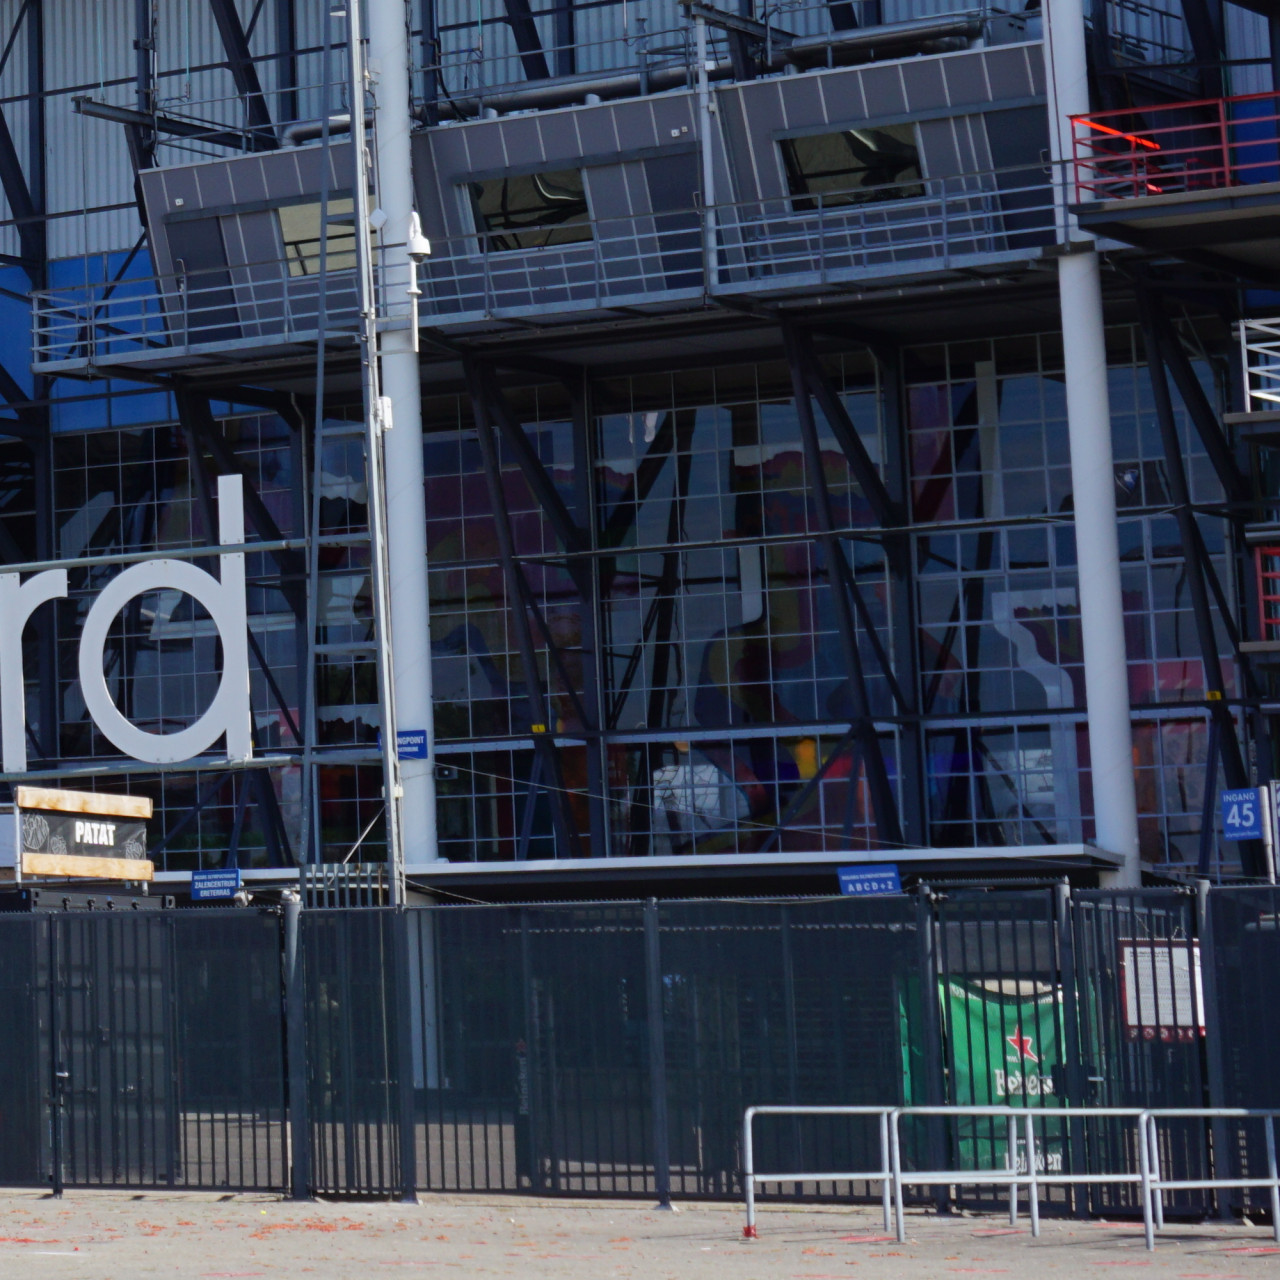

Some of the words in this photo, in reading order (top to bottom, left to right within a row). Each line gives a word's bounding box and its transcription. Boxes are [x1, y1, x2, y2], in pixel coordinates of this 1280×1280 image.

[1223, 792, 1255, 803] INGANG
[1226, 803, 1255, 828] 45
[75, 821, 116, 846] PATAT
